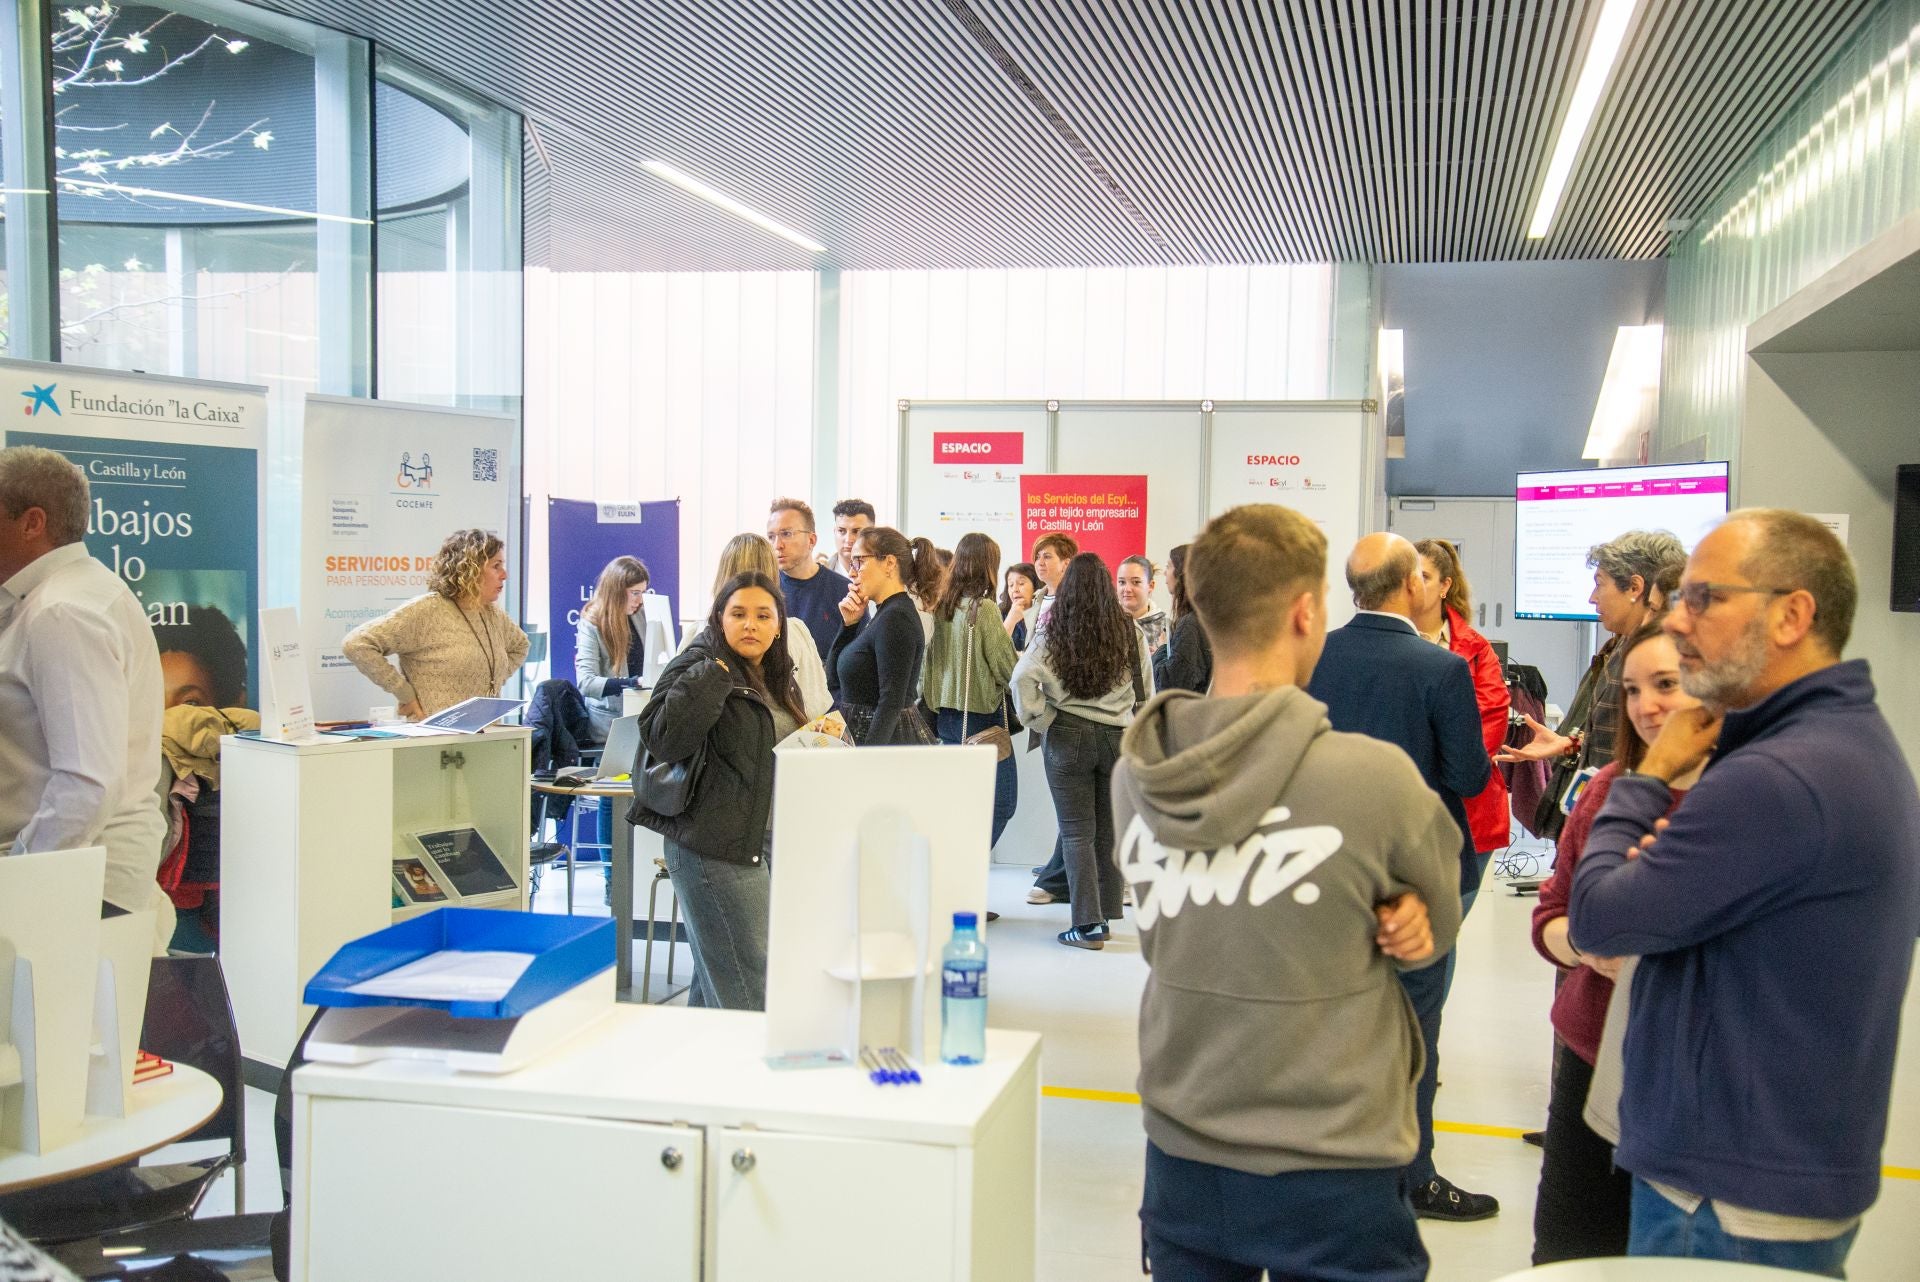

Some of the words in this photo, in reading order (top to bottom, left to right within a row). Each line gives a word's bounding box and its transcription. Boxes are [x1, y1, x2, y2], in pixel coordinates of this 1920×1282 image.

[70, 389, 164, 417] Fundación
[941, 443, 992, 454] ESPACIO
[1247, 455, 1300, 466] ESPACIO
[89, 459, 140, 478] Castilla
[142, 467, 151, 481] y
[154, 463, 186, 480] León
[396, 499, 433, 509] COCEMFE
[1027, 493, 1041, 505] los
[1043, 492, 1088, 505] Servicios
[1090, 493, 1105, 505] del
[1027, 507, 1047, 520] para
[1048, 507, 1057, 518] el
[1059, 506, 1084, 520] tejido
[1086, 506, 1139, 520] empresarial
[87, 497, 193, 545] bajos
[1027, 519, 1038, 531] de
[1040, 519, 1073, 531] Castilla
[1074, 522, 1080, 533] y
[1082, 520, 1104, 532] León
[325, 555, 410, 572] SERVICIOS
[327, 575, 353, 586] PARA
[356, 575, 407, 587] PERSONAS
